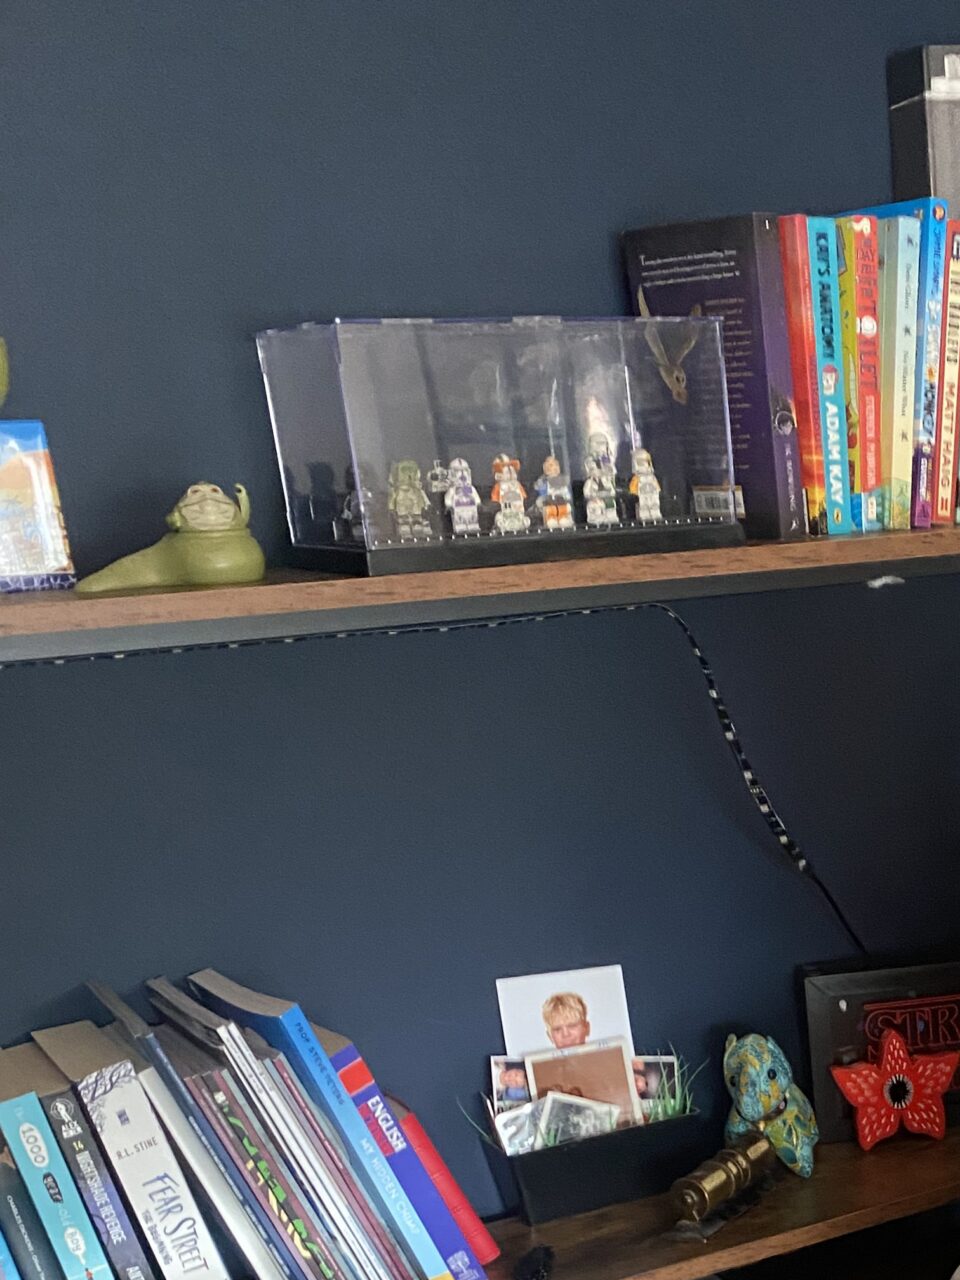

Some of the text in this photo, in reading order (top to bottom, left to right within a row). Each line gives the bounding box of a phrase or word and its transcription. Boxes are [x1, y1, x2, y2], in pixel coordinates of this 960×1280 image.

[825, 402, 843, 504] ADAM KAY
[940, 382, 955, 487] MATT HAIG
[134, 1136, 158, 1154] STINE
[357, 1137, 375, 1158] MY
[369, 1156, 400, 1199] HIDDEN
[365, 1094, 408, 1153] ENGLISH
[75, 1149, 127, 1245] NIGHTSHADE REVENGE
[141, 1169, 210, 1279] FEAR STREET
